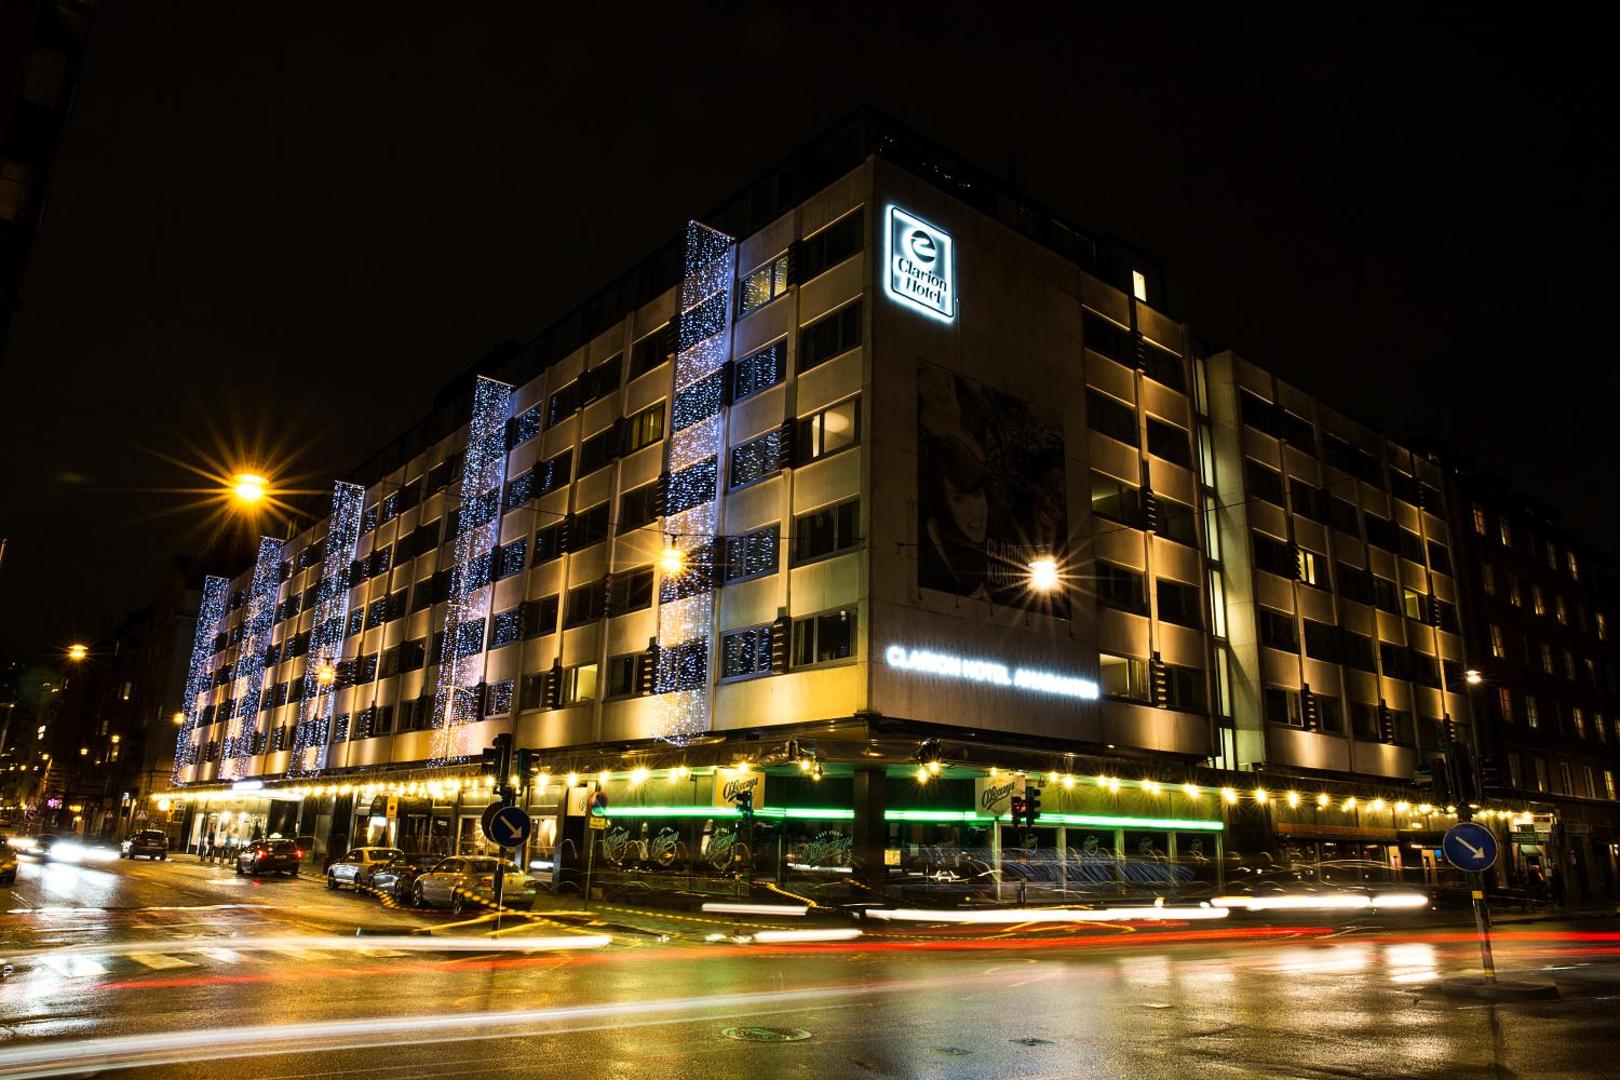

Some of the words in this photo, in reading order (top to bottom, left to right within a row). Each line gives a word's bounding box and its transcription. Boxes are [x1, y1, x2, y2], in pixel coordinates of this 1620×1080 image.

[898, 257, 947, 292] Clarion
[906, 277, 942, 304] Hotel
[887, 645, 961, 677] CLARION
[963, 659, 1011, 686] HOTEL
